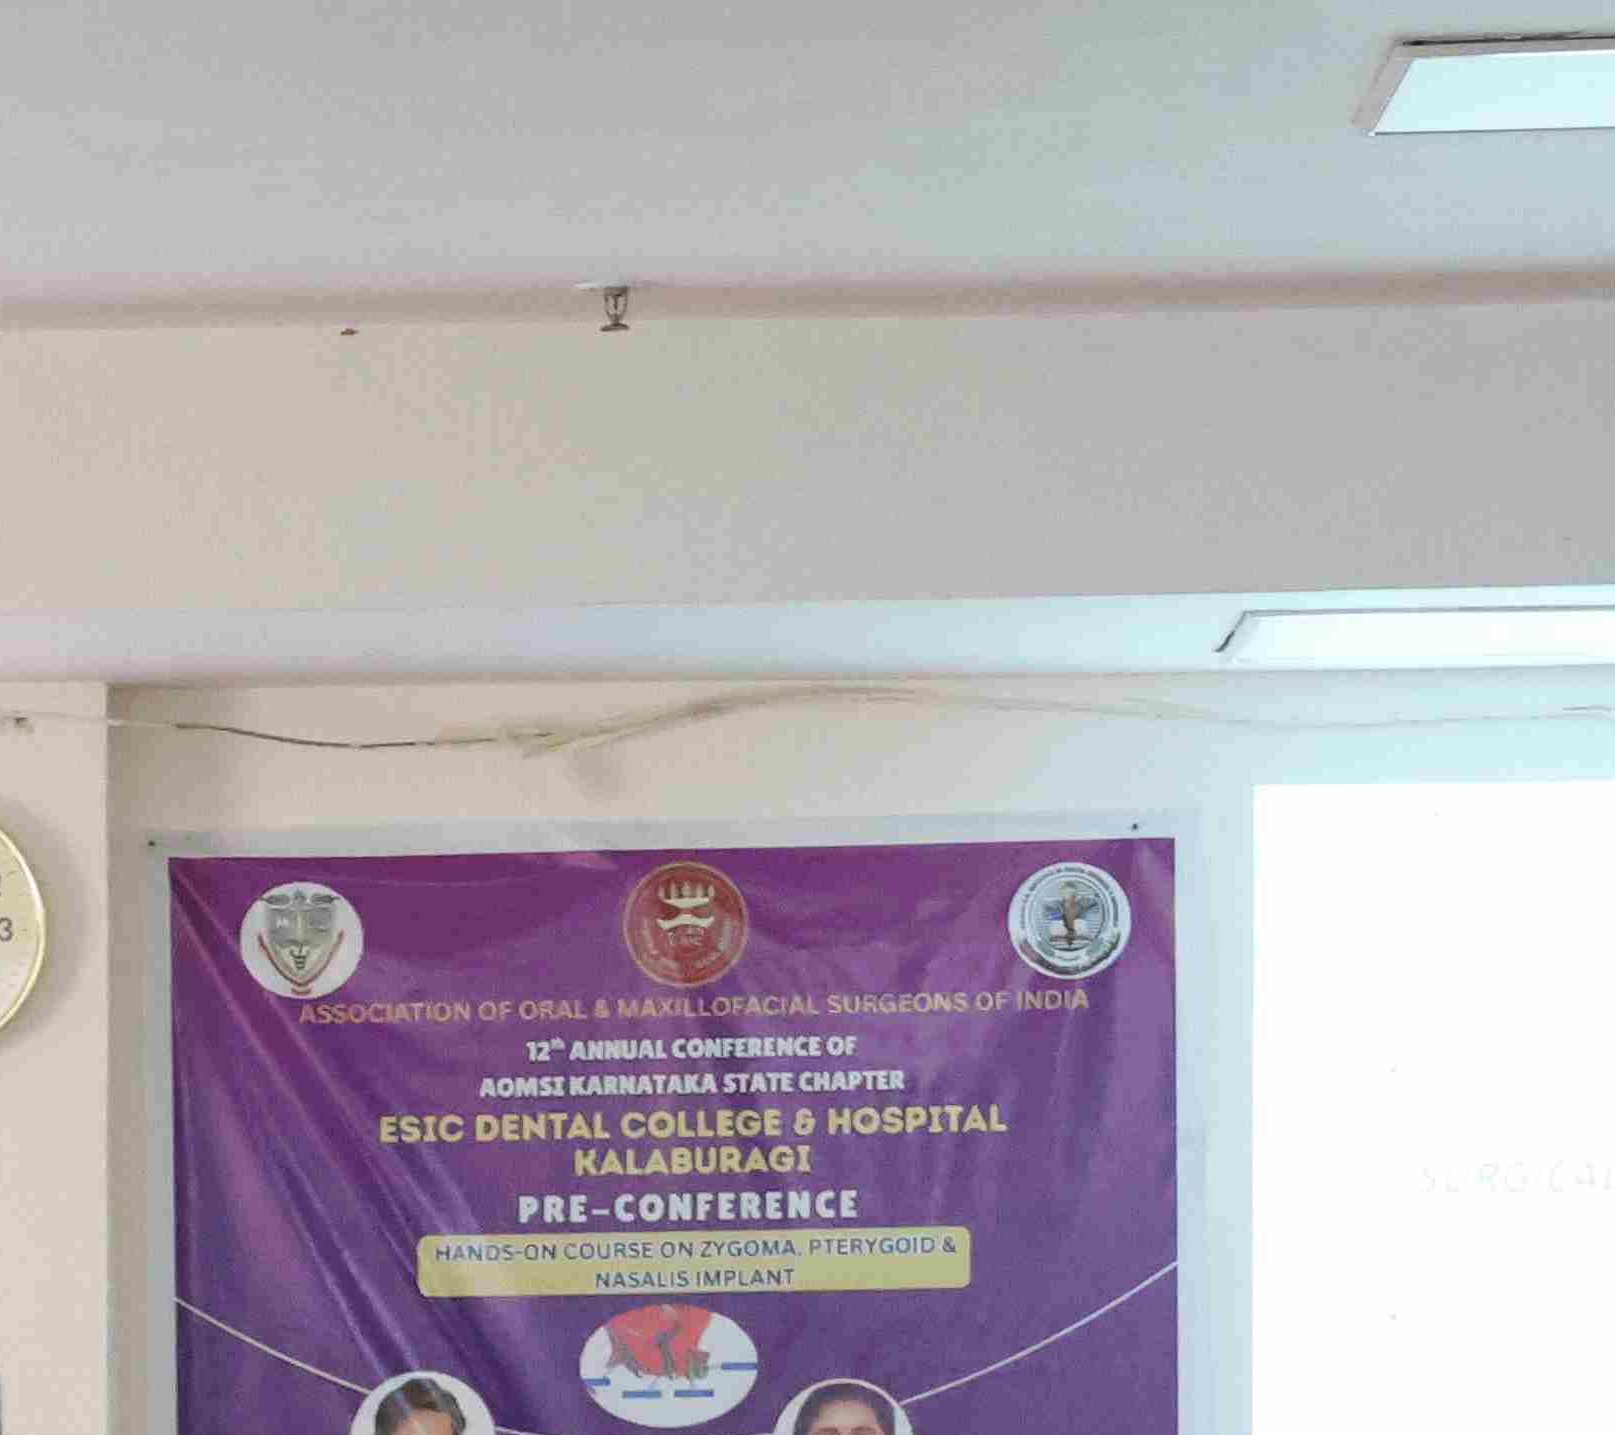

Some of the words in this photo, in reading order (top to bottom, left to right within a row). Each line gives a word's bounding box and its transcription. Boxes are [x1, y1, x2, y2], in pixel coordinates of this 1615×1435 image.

[299, 1000, 471, 1025] ASSOCIATION
[478, 999, 512, 1022] OF
[519, 998, 587, 1021] ORAL
[593, 999, 612, 1019] &
[618, 994, 819, 1019] MAXILLOFACIAL
[826, 991, 967, 1016] SURGEONS
[974, 990, 1008, 1012] OF
[1015, 988, 1090, 1011] INDIA
[569, 1038, 667, 1061] ANNUAL
[672, 1037, 821, 1059] CONFERENCE
[826, 1035, 858, 1057] OF
[479, 1075, 565, 1099] AOMSI
[570, 1073, 718, 1097] KARNATAKA
[723, 1071, 794, 1094] STATE
[798, 1069, 906, 1092] CHAPTER
[379, 1115, 465, 1143] ESIC
[475, 1112, 611, 1142] DENTAL
[620, 1108, 783, 1140] COLLEGE
[792, 1107, 817, 1136] &
[827, 1103, 1009, 1136] HOSPITAL
[574, 1145, 812, 1177] KALABURAGI
[518, 1190, 859, 1224] PRE-CONFERENCE
[434, 1243, 556, 1262] HANDS-ON
[563, 1242, 653, 1261] COURSE
[659, 1241, 694, 1260] ON
[809, 1236, 936, 1257] PTERYGOID
[941, 1235, 957, 1253] &
[594, 1270, 691, 1290] NASALIS
[696, 1267, 796, 1288] IMPLANT
